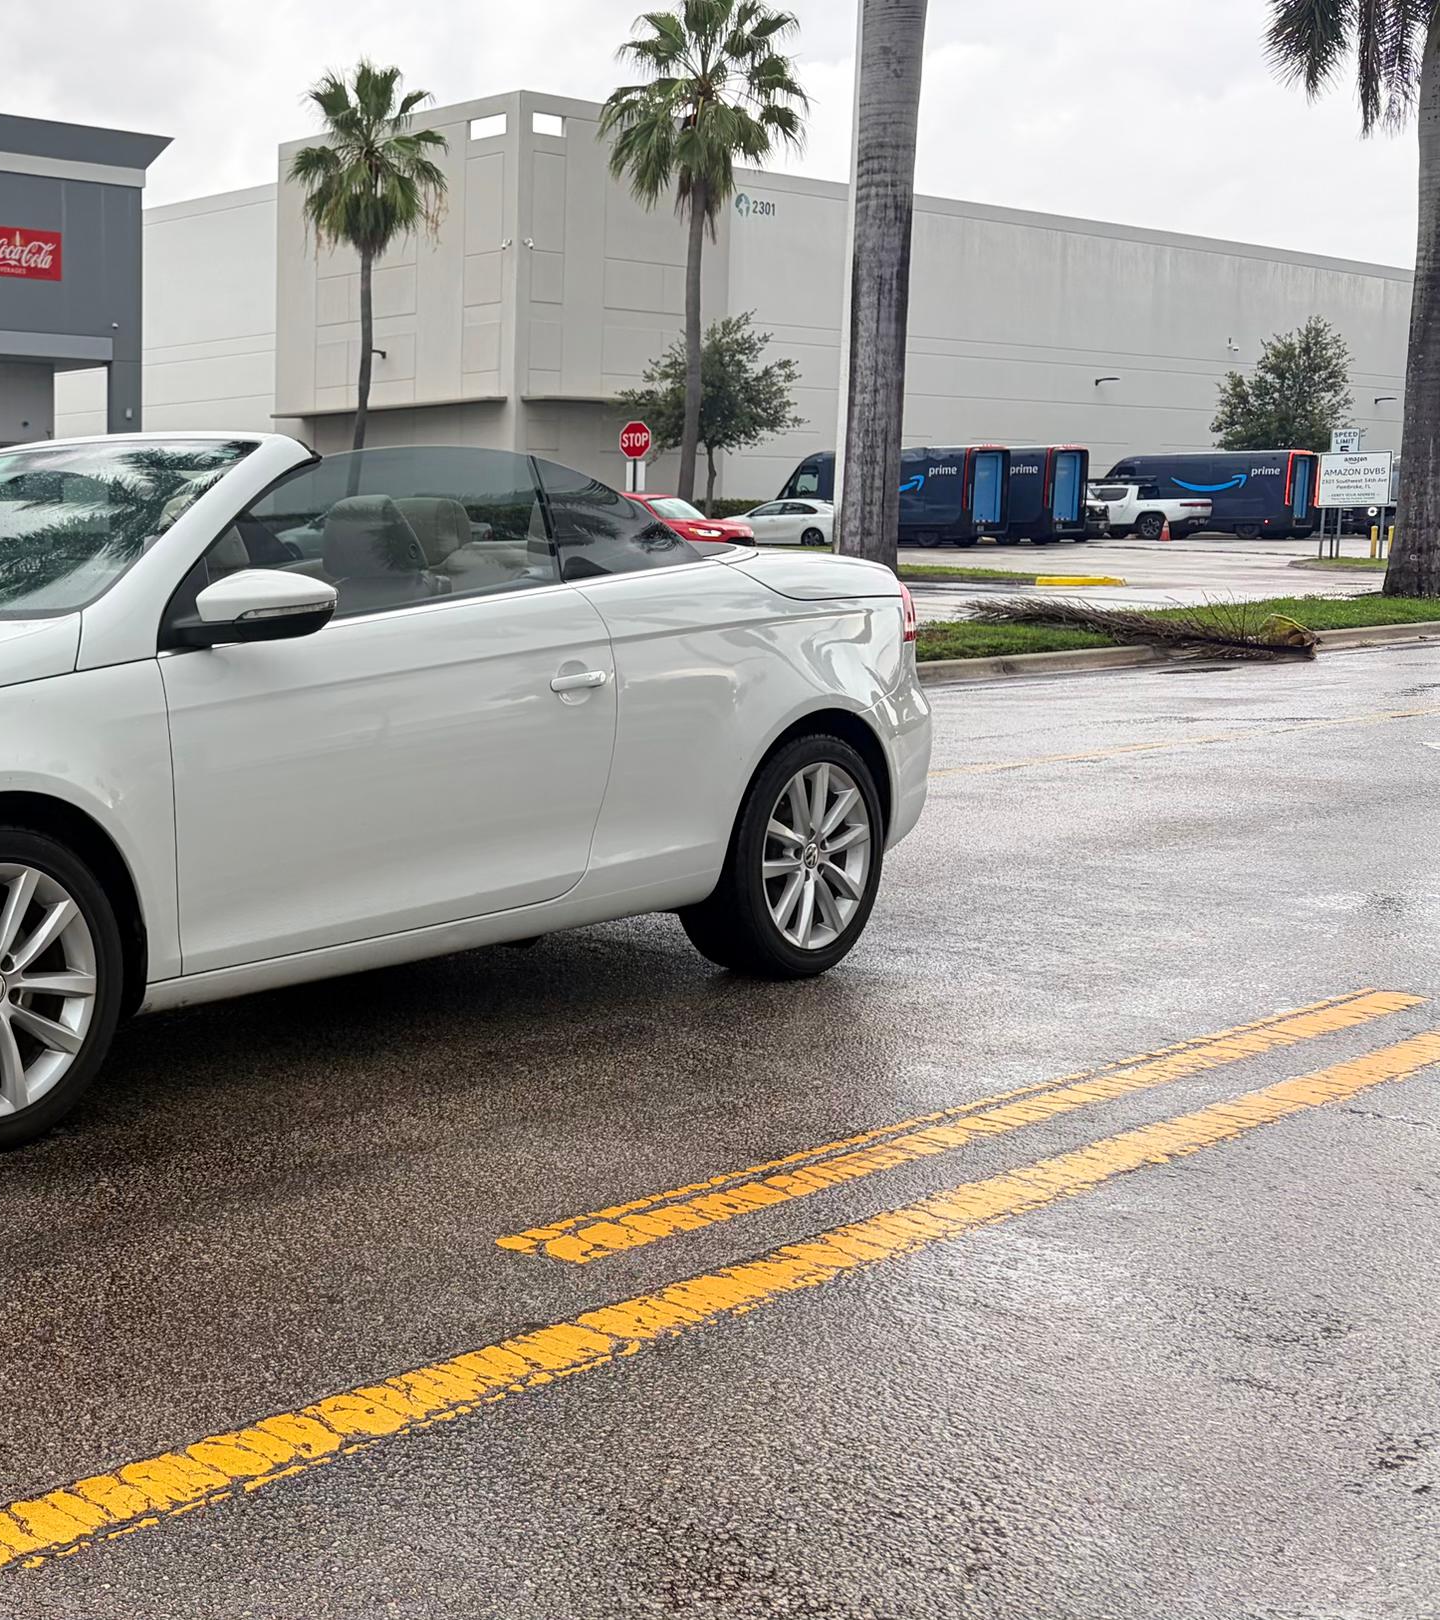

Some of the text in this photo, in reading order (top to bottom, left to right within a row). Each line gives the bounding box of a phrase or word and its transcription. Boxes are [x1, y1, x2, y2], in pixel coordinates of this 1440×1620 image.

[752, 200, 775, 216] 2301
[622, 432, 649, 448] STOP
[929, 464, 957, 477] prime
[1010, 464, 1039, 476] prime
[1251, 466, 1281, 477] prime
[1324, 467, 1386, 476] AMAZON DVB5
